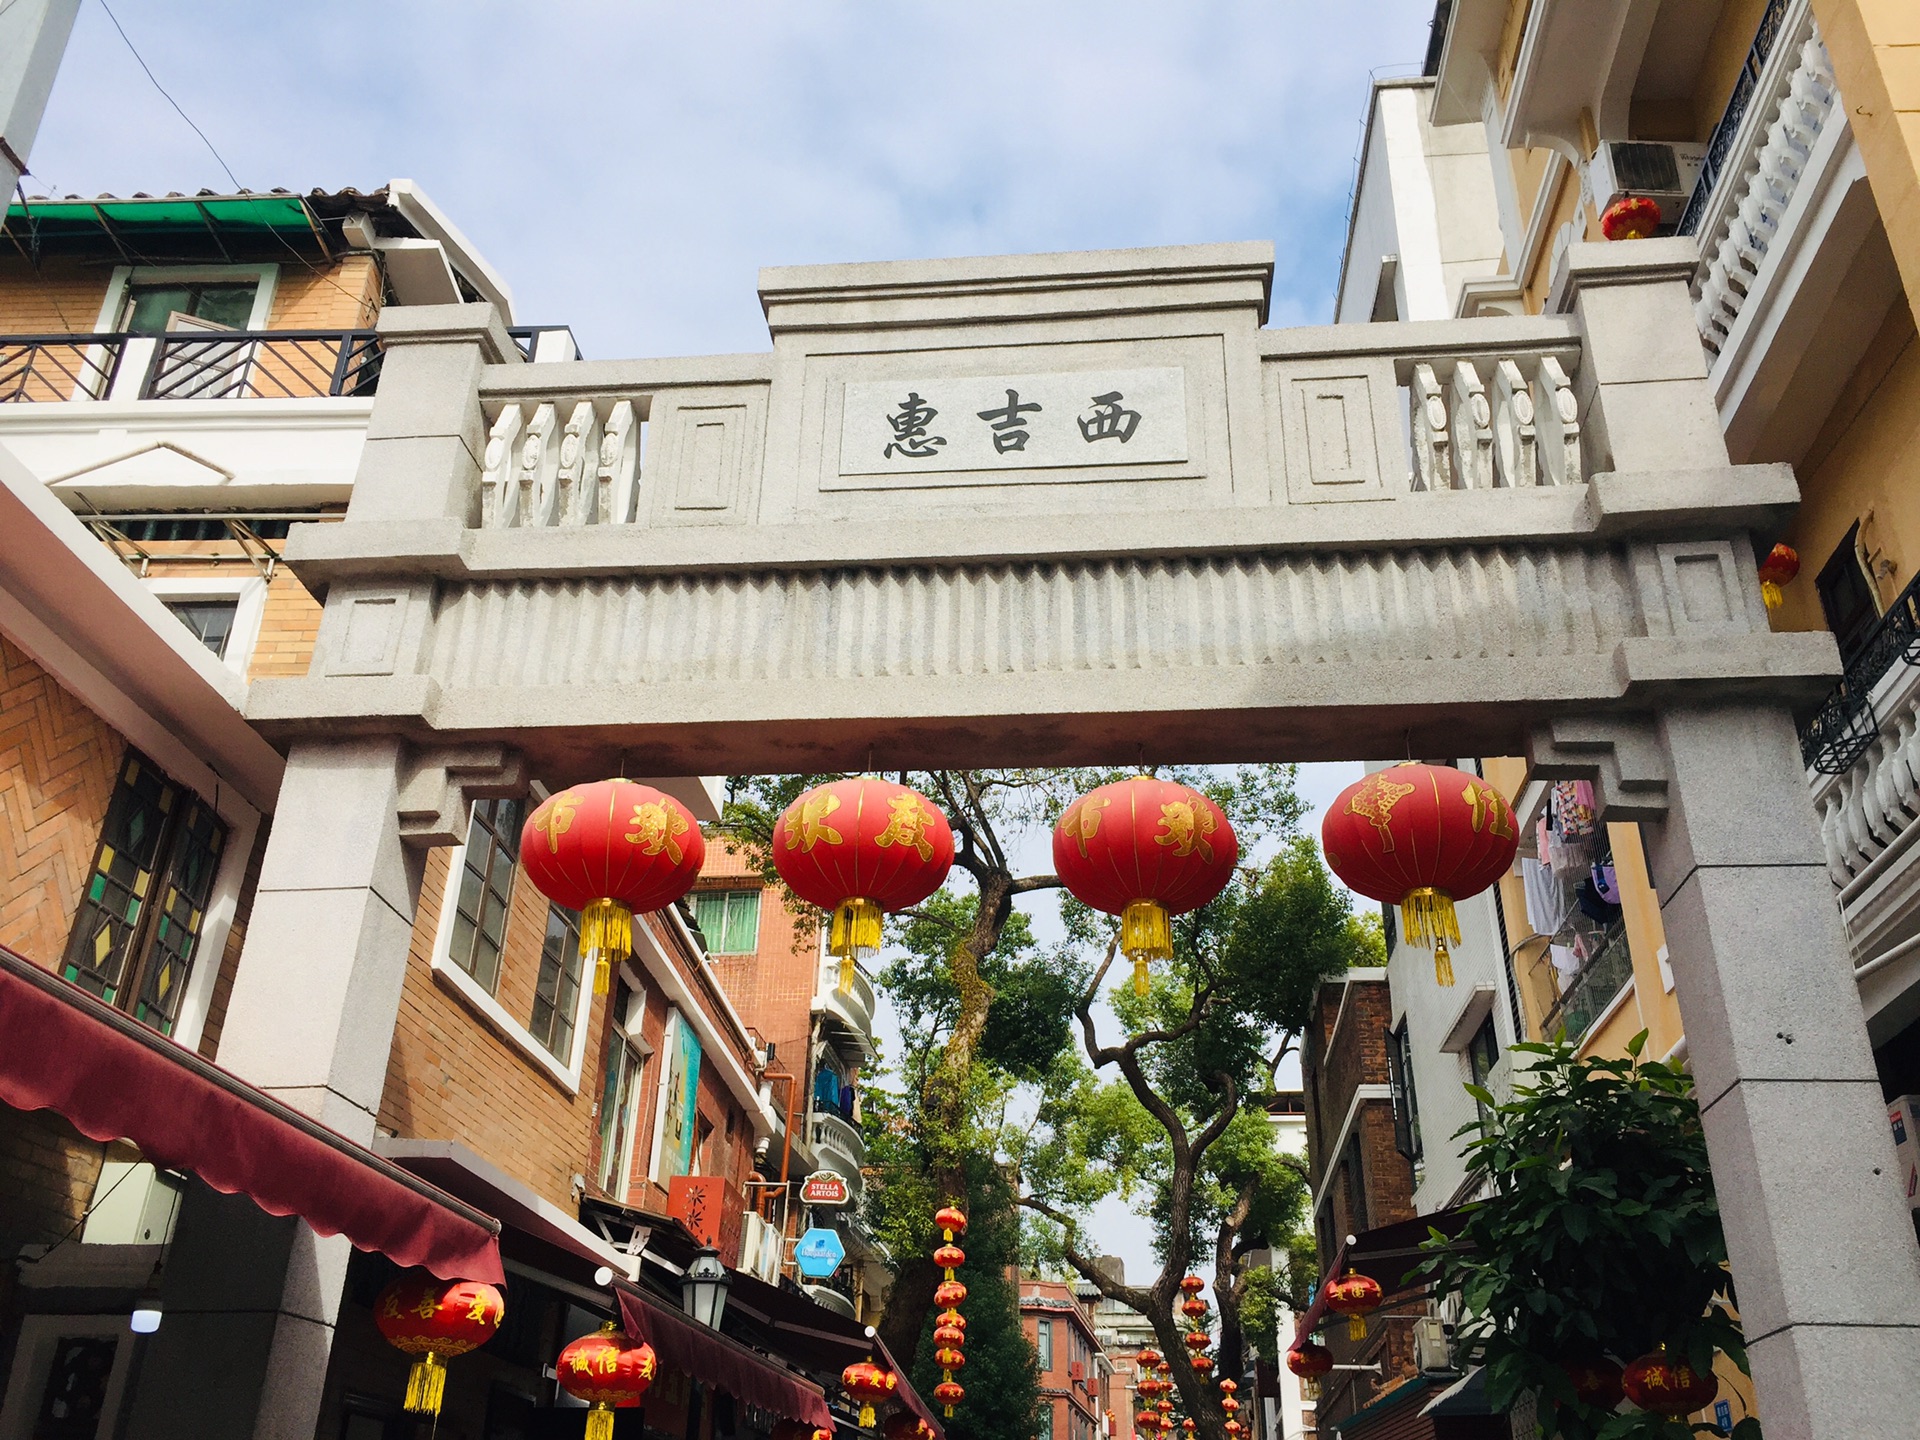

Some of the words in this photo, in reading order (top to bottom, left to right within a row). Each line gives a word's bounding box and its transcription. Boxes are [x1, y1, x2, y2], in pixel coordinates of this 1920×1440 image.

[810, 1190, 840, 1198] ARTOIS
[811, 1183, 839, 1191] STELLA
[569, 1346, 621, 1377] 诚信
[1643, 1366, 1691, 1391] 诚信
